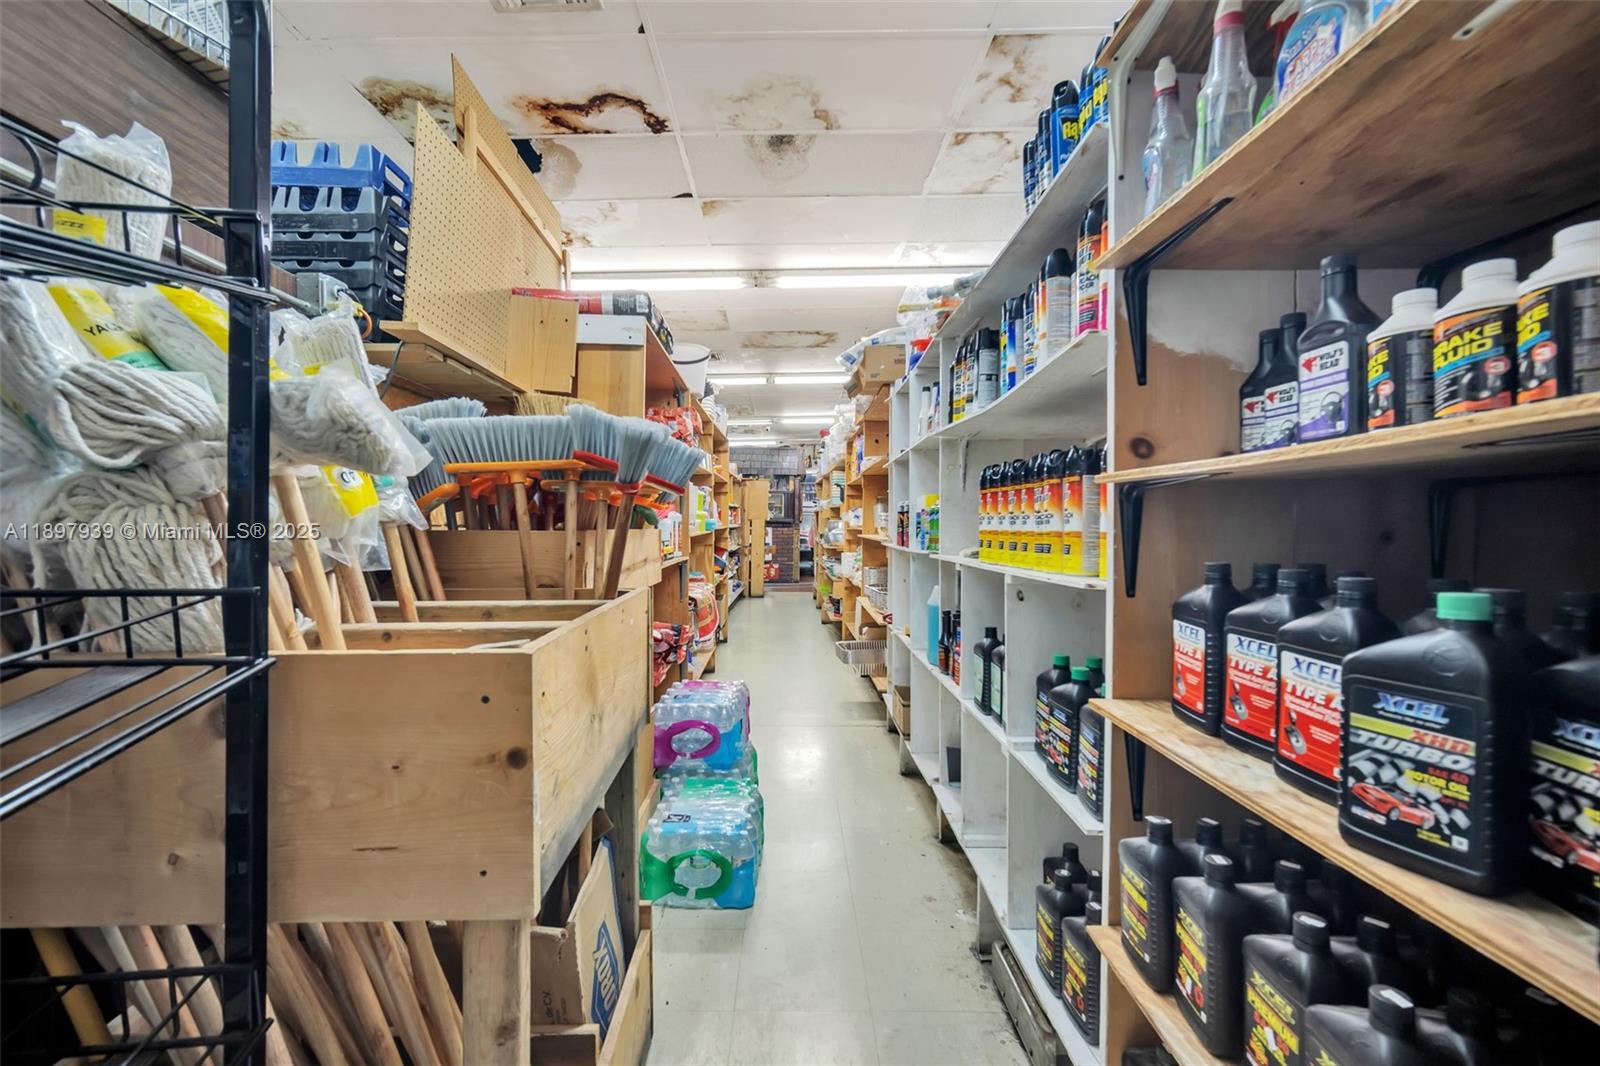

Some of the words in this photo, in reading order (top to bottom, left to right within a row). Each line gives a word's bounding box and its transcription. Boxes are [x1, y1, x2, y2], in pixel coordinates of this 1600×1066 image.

[1234, 636, 1277, 659] XCEL
[1230, 656, 1265, 677] TYPE
[1290, 656, 1341, 684] XCEL
[1285, 678, 1329, 706] TYPE
[1372, 691, 1450, 725] XCEL
[1409, 728, 1472, 755] XHD
[1552, 717, 1600, 749] XC
[1350, 727, 1475, 776] TURBO
[1403, 767, 1447, 789] MOTOR
[1533, 758, 1600, 799] TUR
